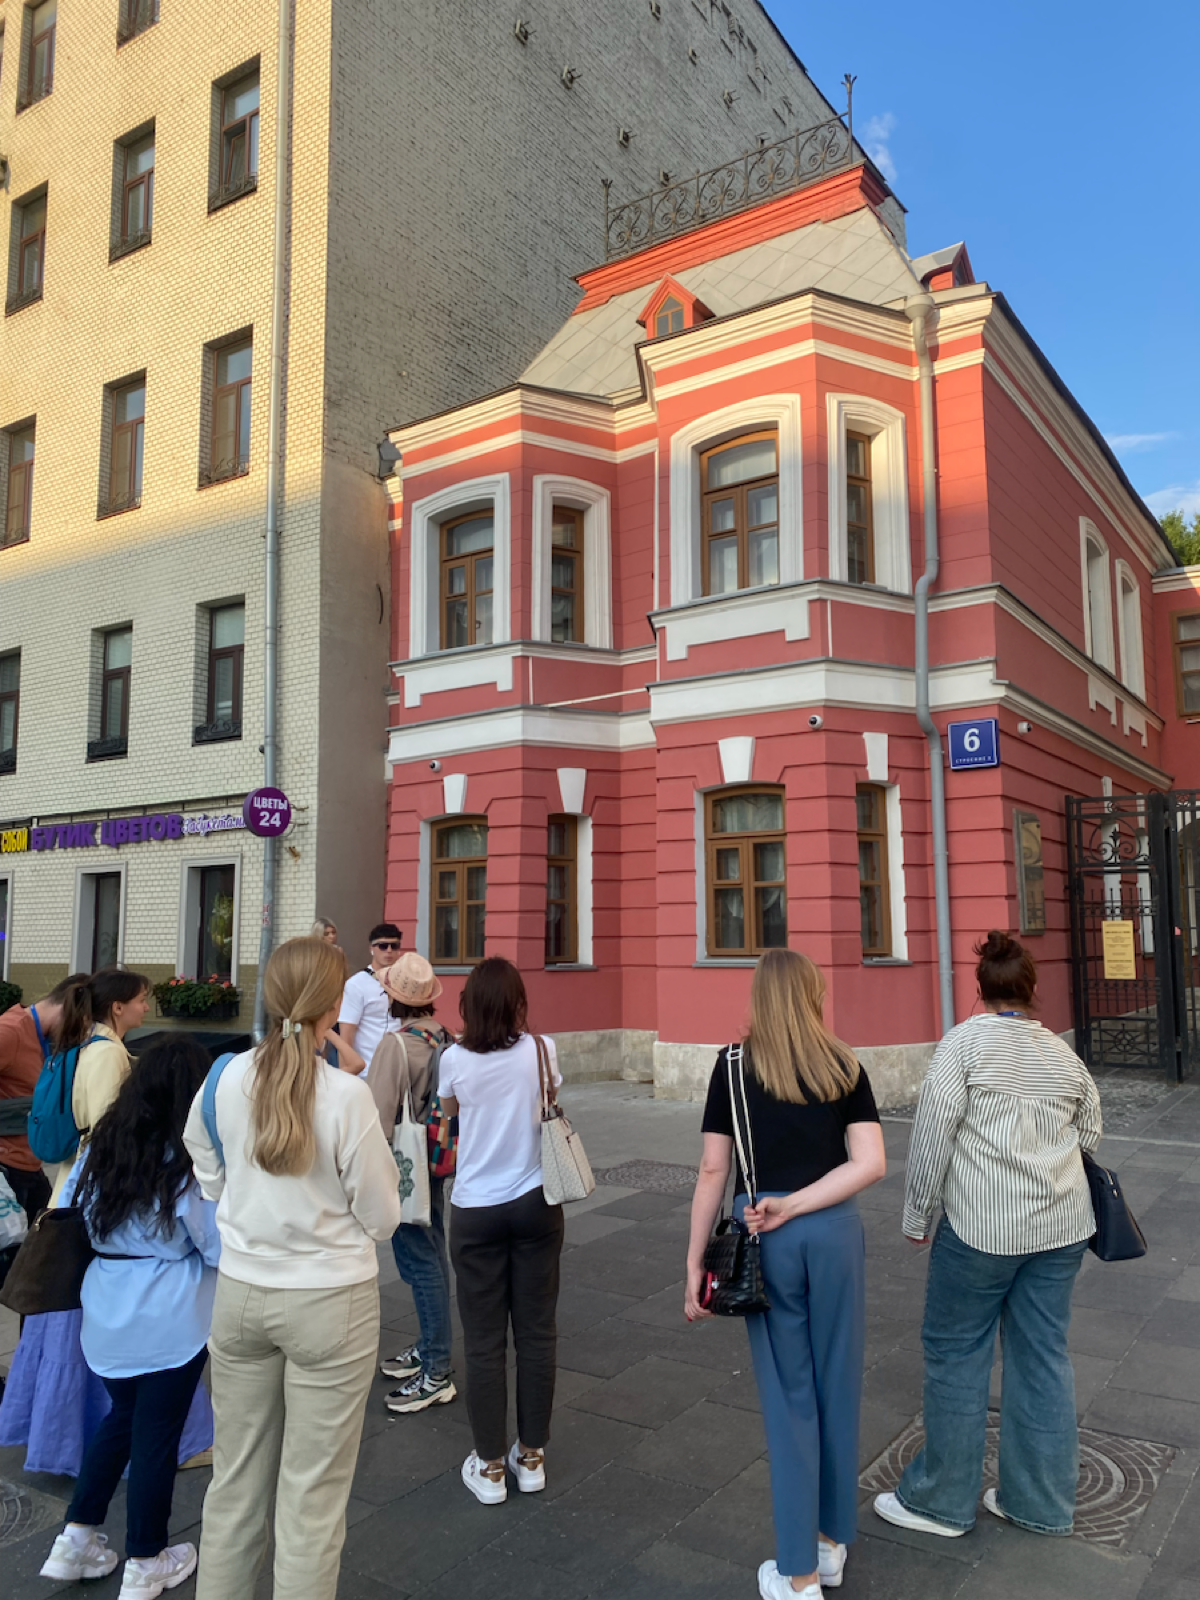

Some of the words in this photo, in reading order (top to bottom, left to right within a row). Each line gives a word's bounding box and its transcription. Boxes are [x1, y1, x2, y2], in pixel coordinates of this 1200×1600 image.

[963, 728, 981, 752] 6
[250, 796, 288, 810] ЦВЕТЫ
[259, 811, 282, 828] 24
[31, 822, 96, 849] БУТИК
[101, 813, 183, 847] ЦВЕТОВ
